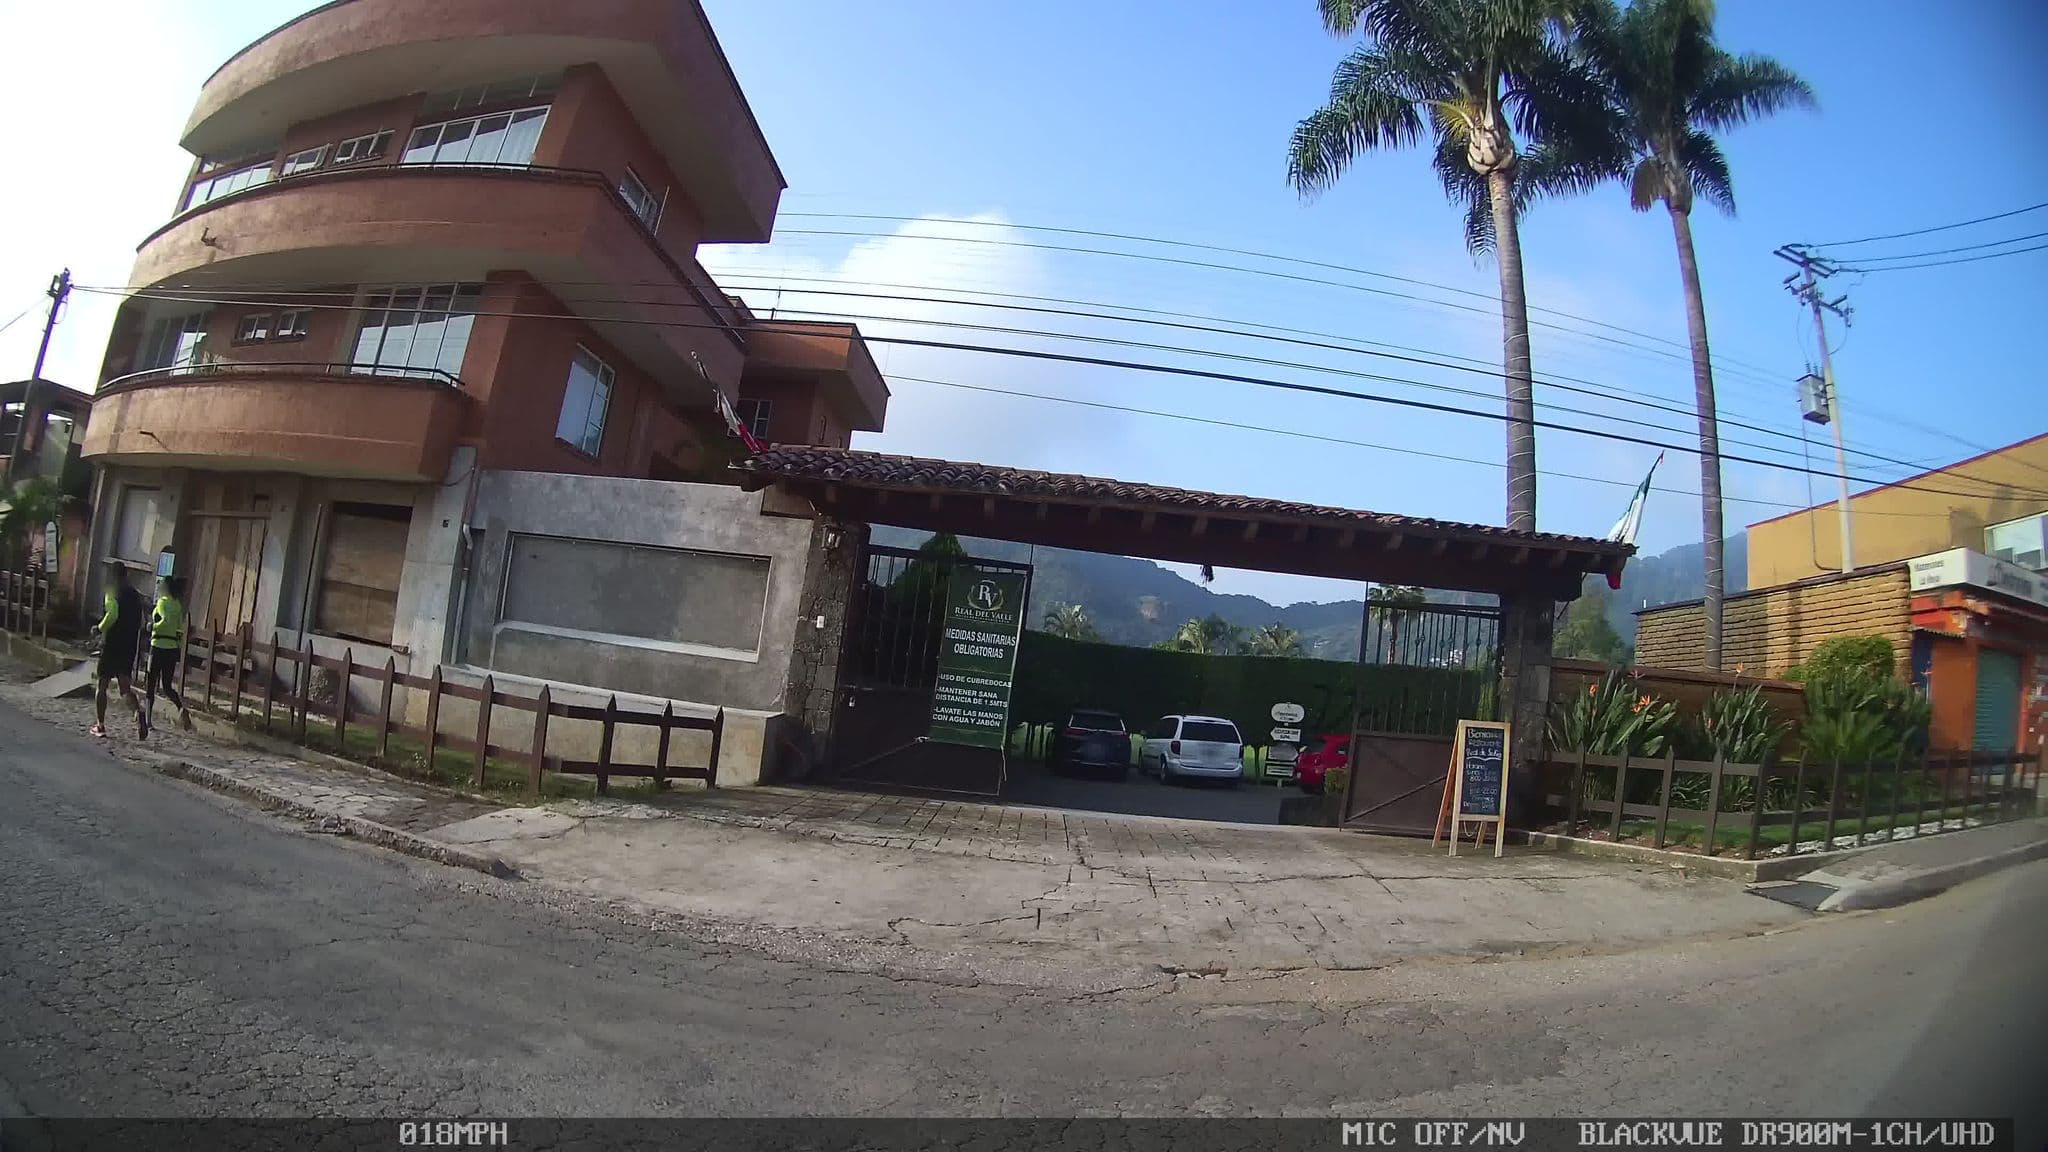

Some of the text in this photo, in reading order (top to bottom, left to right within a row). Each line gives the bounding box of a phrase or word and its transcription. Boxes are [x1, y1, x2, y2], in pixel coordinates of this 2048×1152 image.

[954, 607, 974, 616] REAL
[975, 610, 989, 618] DEL
[991, 612, 1012, 621] VALLE
[945, 628, 1016, 647] MEDIDAS SANITARIAS
[953, 643, 1004, 659] OBLIGATORIAS
[966, 677, 1012, 688] CUBREBOCAS
[935, 694, 972, 703] DISTANCIA
[978, 691, 998, 699] SANA
[978, 711, 1003, 720] MANOS
[948, 716, 969, 724] AGUA
[976, 718, 1001, 727] JABÓN
